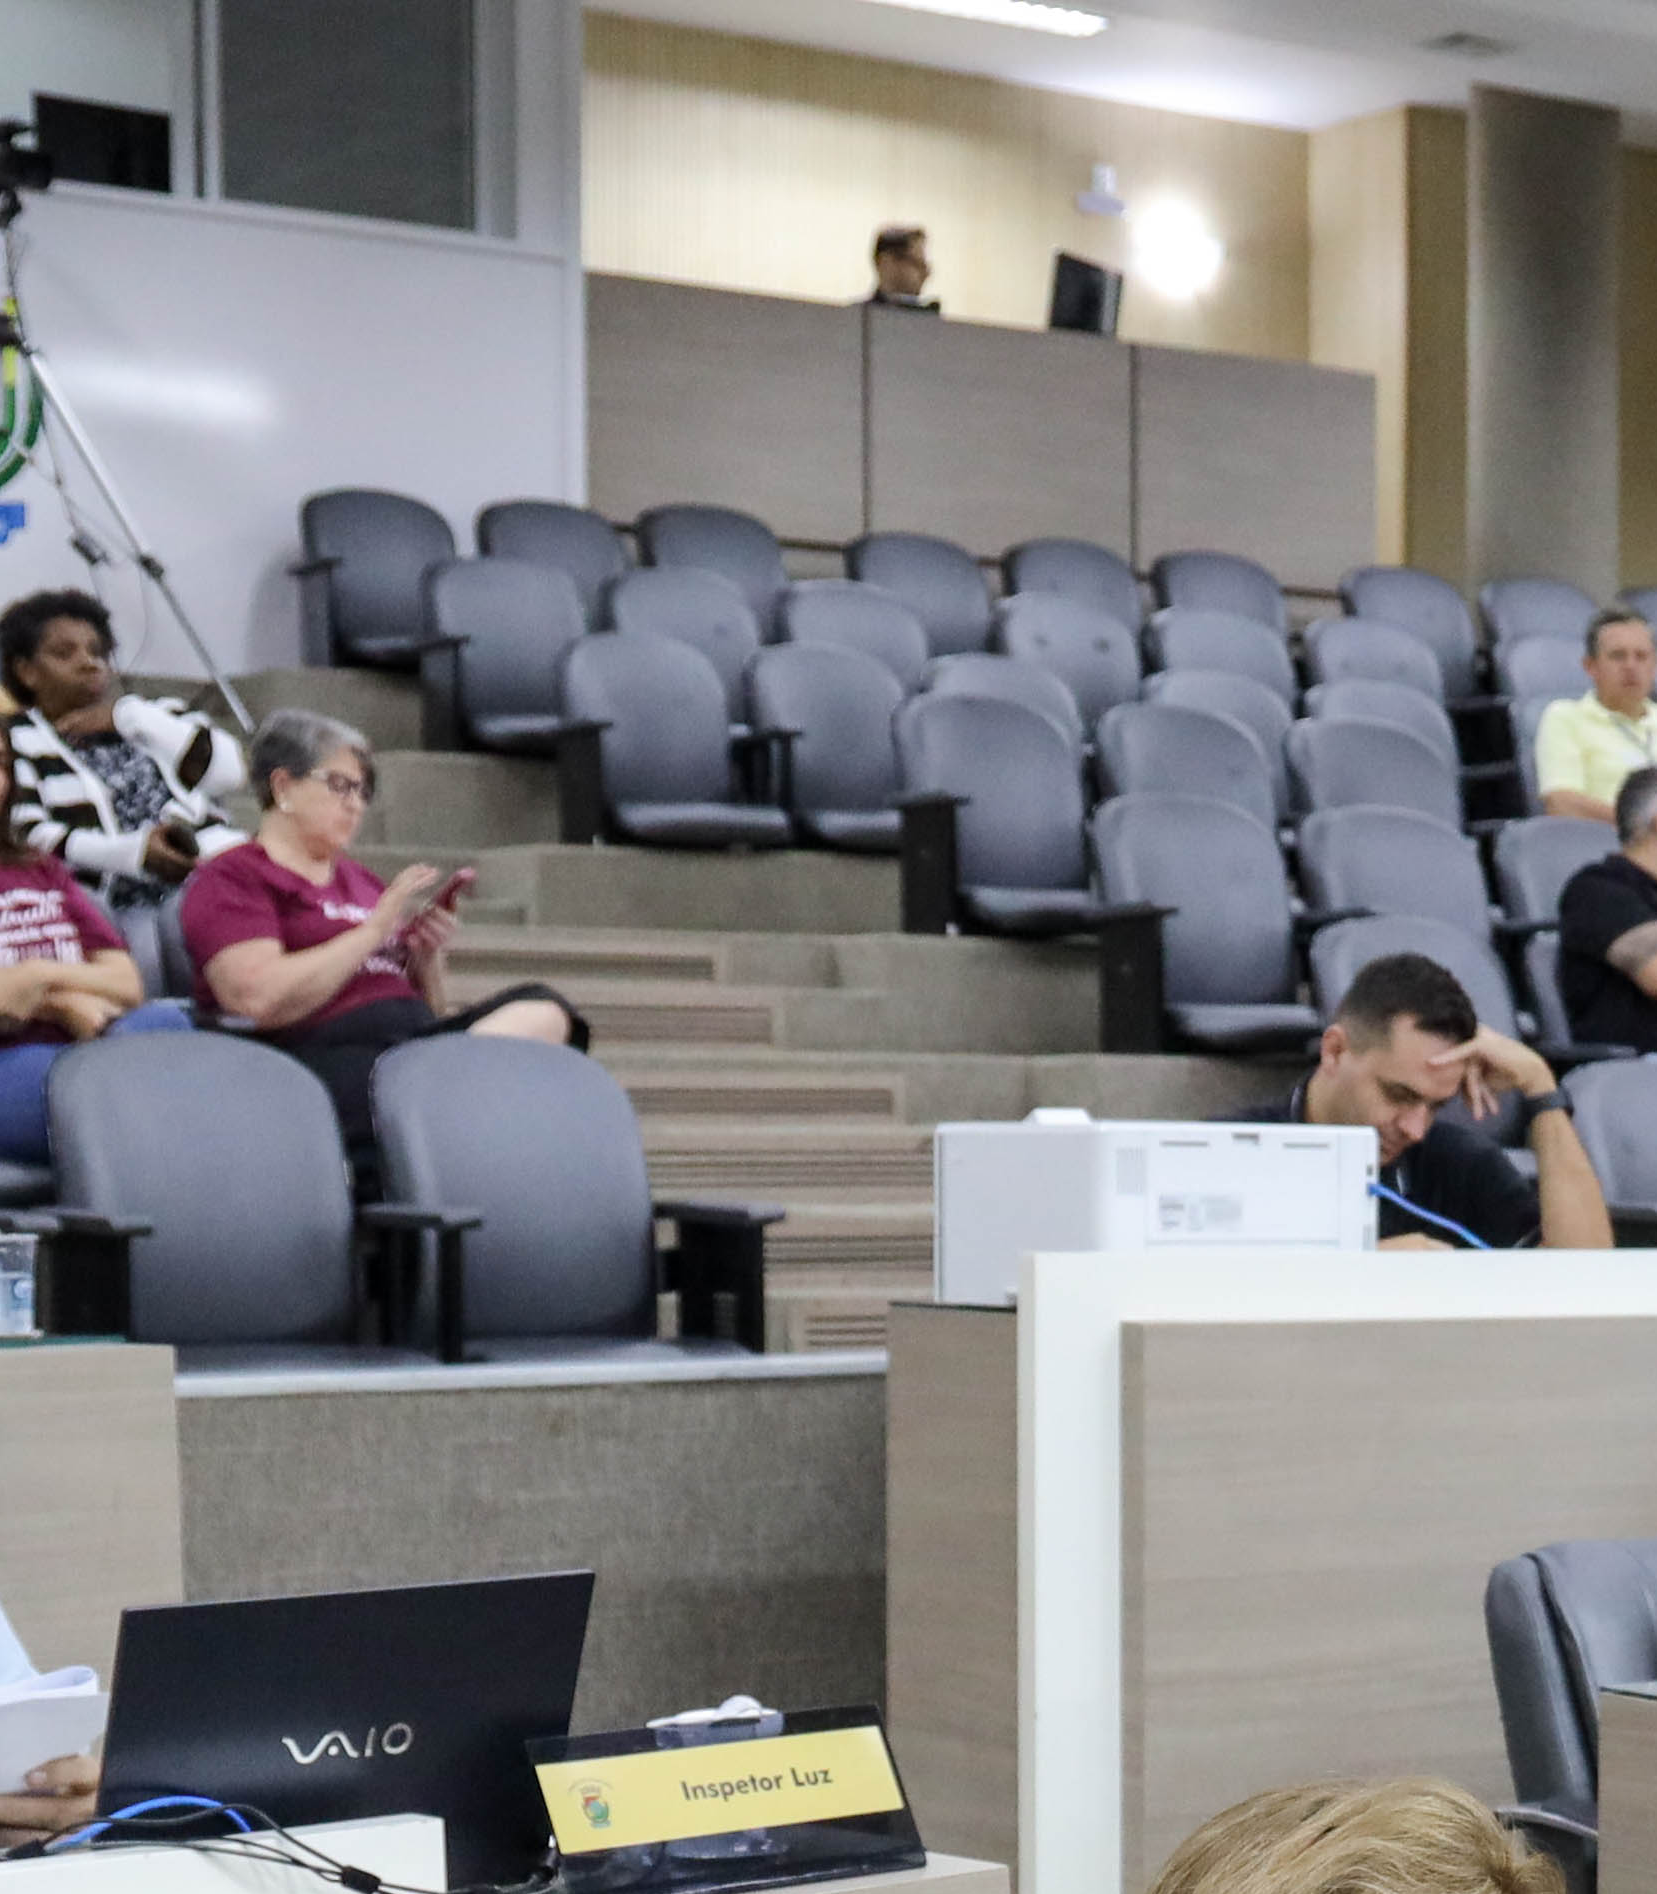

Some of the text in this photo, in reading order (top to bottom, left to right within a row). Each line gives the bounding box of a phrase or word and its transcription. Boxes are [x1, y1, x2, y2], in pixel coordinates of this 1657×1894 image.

[281, 1722, 413, 1764] VAIO
[680, 1767, 833, 1802] Inspetor Luz
